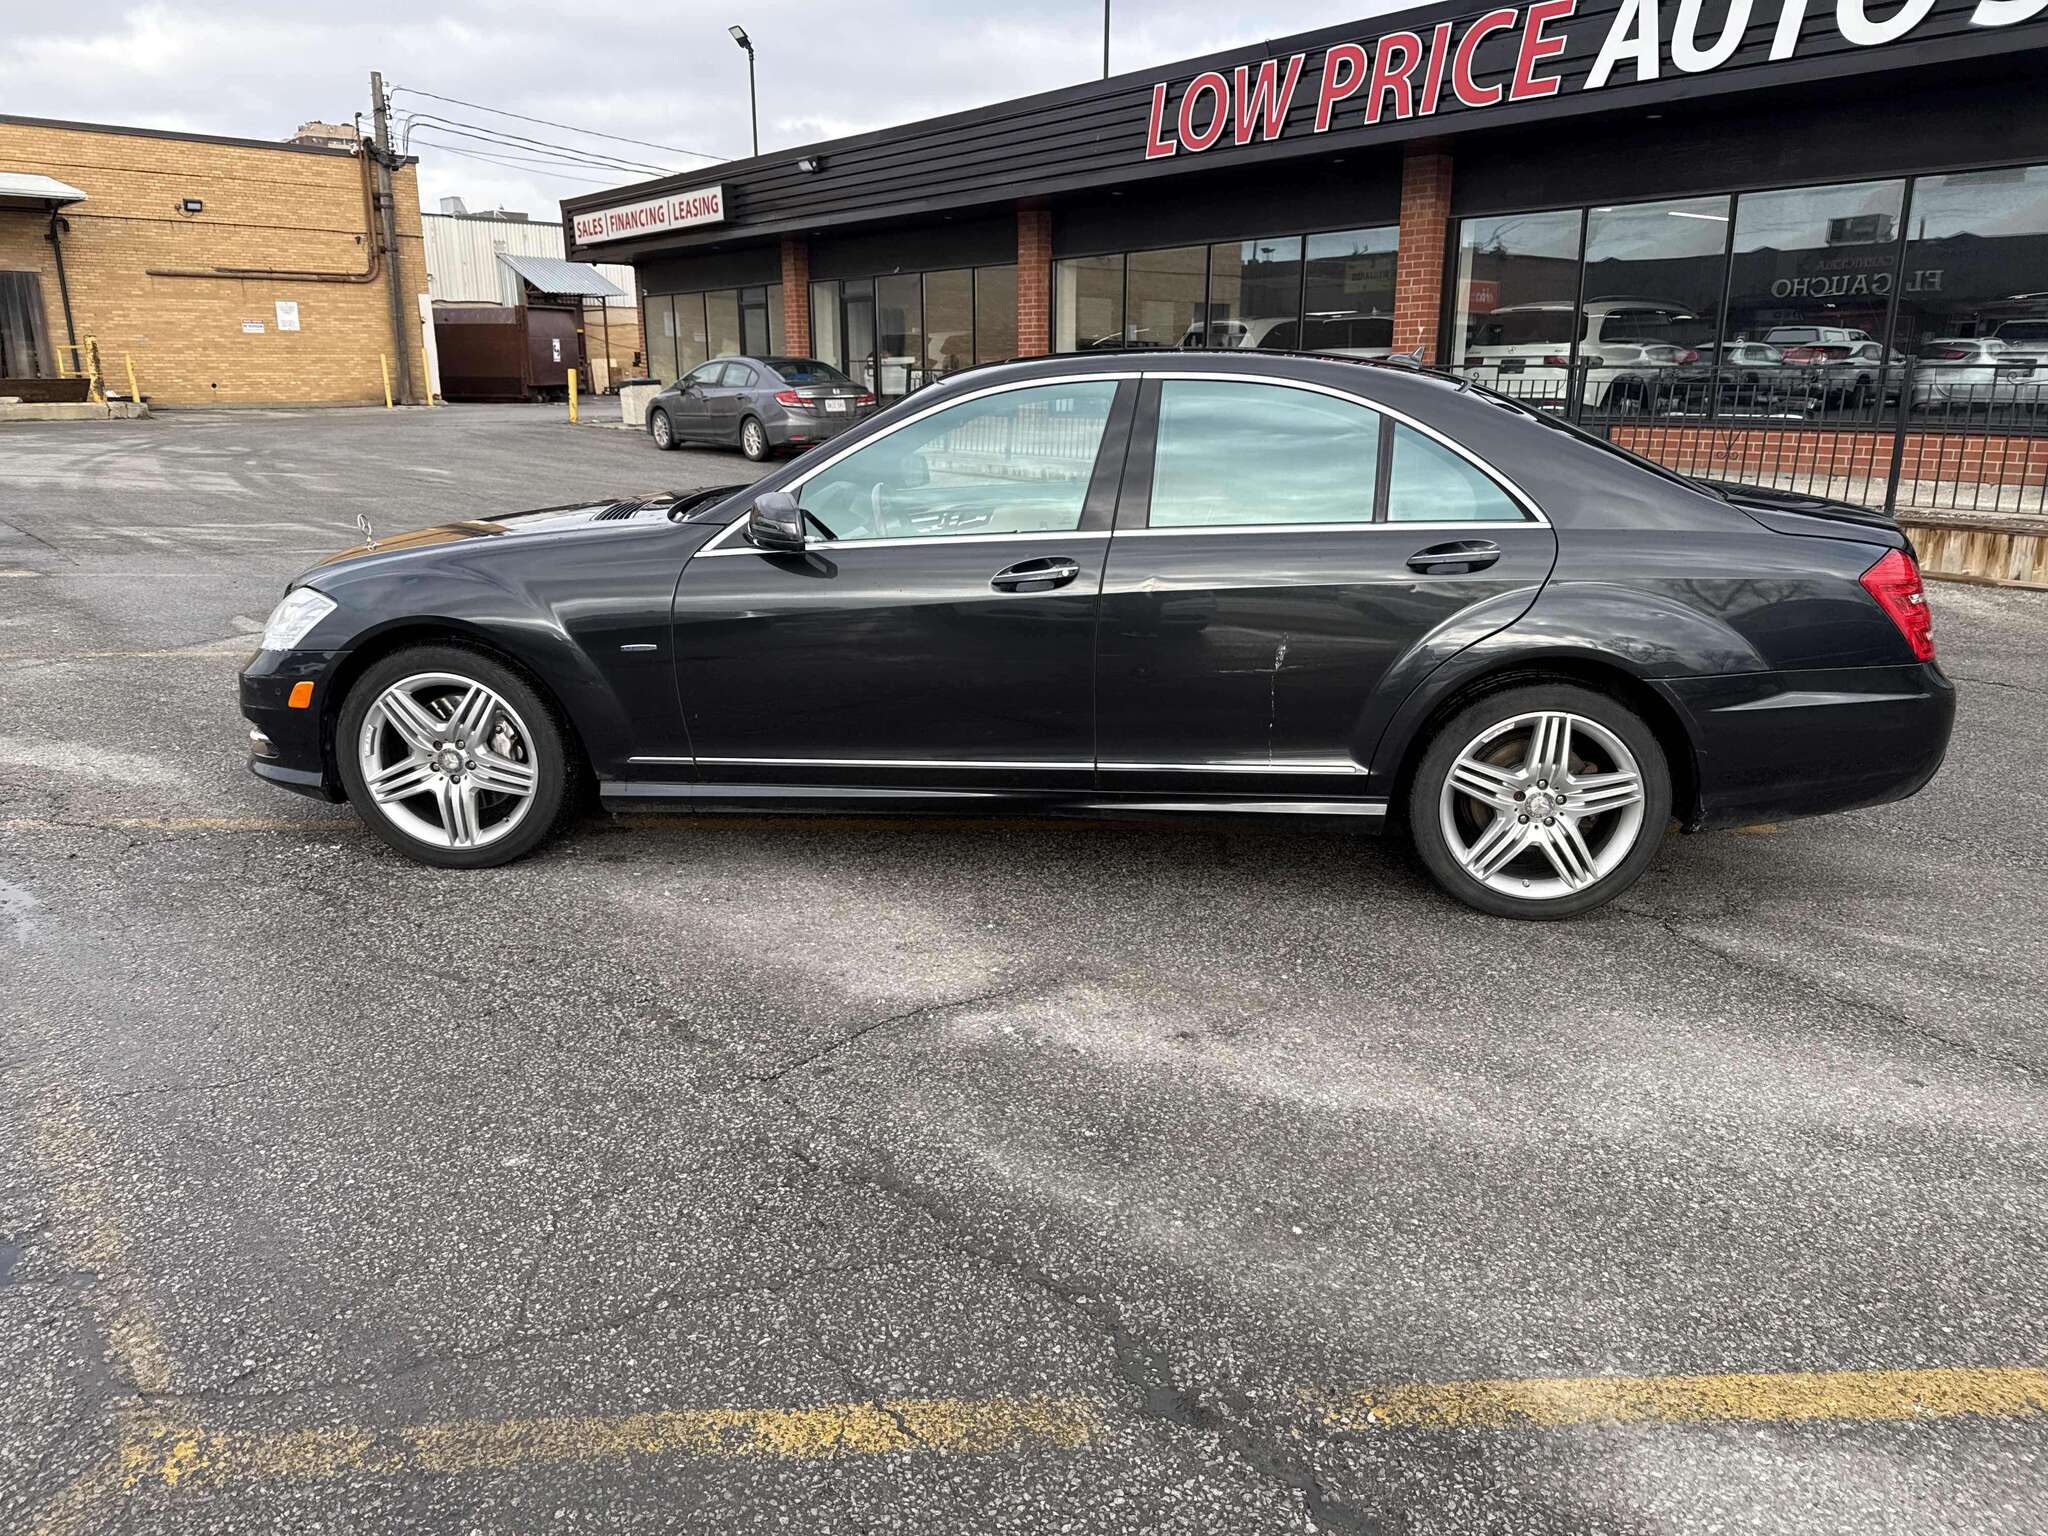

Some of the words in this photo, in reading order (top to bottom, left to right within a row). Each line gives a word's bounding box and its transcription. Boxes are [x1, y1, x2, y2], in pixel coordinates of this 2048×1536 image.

[1145, 53, 1305, 159] LOW
[1313, 0, 1577, 133] PRICE
[577, 217, 603, 238] SALES
[609, 205, 664, 232] FINANCING
[673, 194, 719, 220] LEASING
